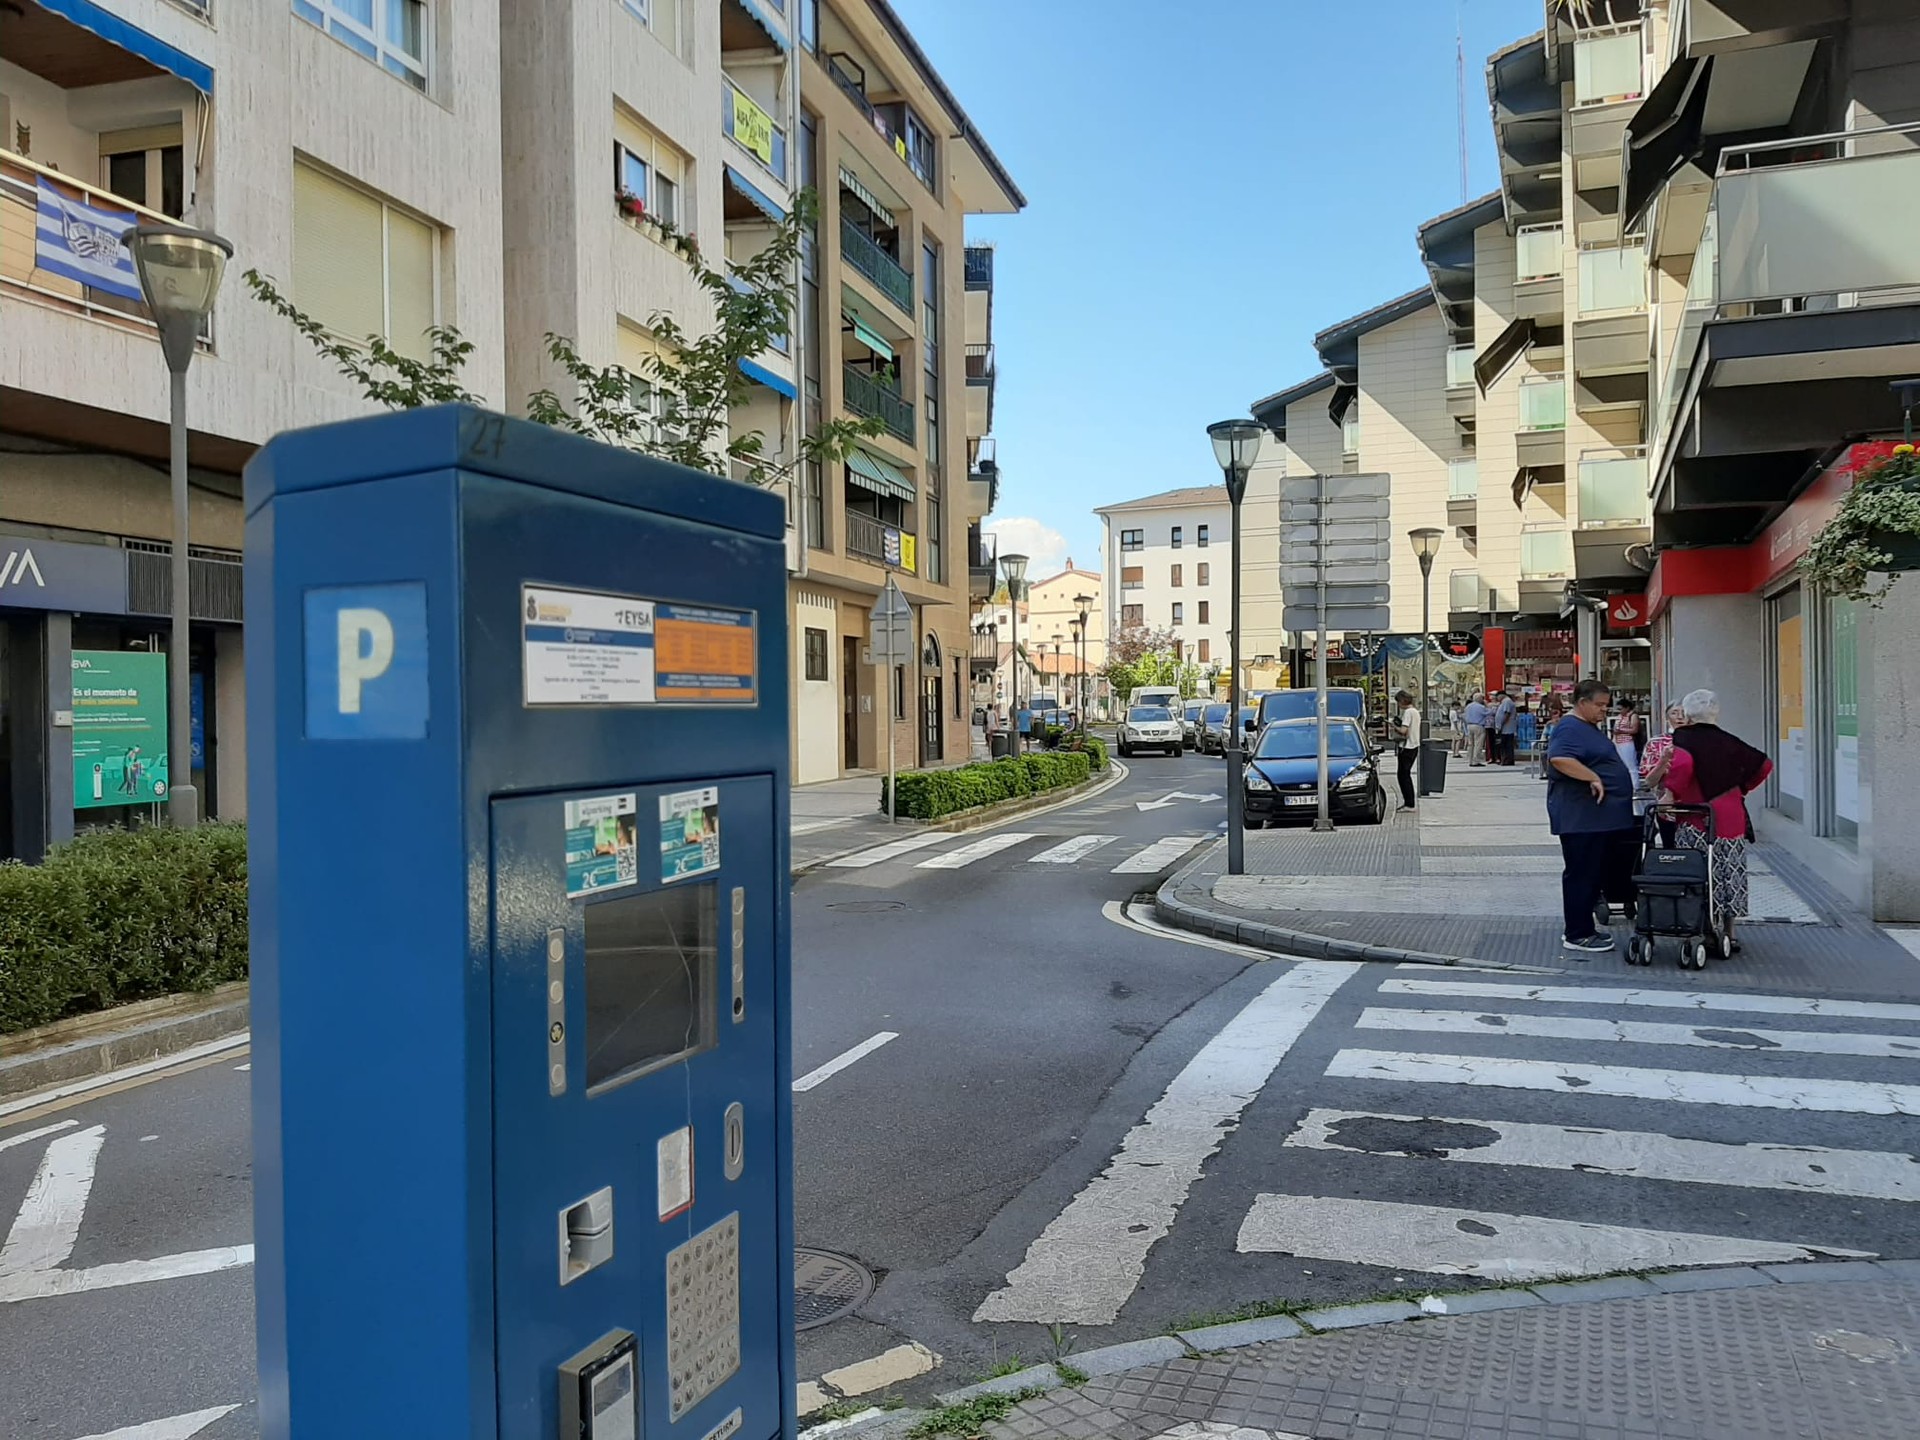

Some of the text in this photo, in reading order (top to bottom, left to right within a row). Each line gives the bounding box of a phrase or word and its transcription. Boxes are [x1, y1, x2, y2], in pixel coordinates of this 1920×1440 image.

[470, 413, 505, 460] 27
[337, 608, 395, 714] P
[73, 688, 83, 697] Es
[83, 688, 91, 697] el
[92, 688, 127, 697] momento
[582, 870, 599, 889] 2€
